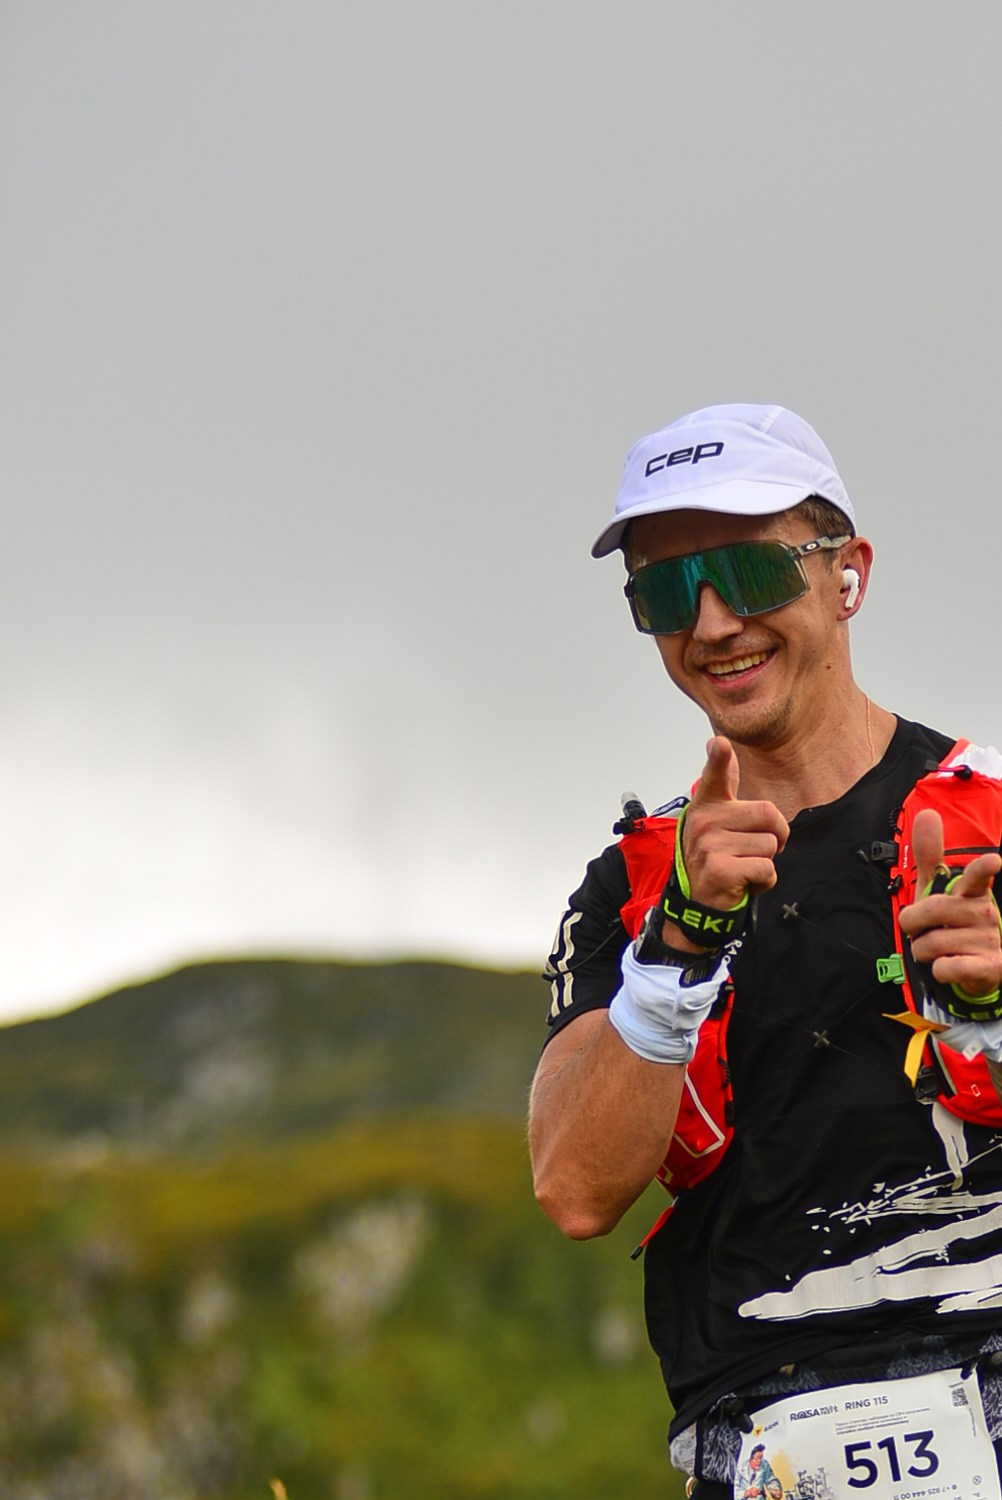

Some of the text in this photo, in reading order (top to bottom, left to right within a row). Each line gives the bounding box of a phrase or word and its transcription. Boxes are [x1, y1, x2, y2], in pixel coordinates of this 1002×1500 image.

[644, 442, 725, 478] cep
[663, 898, 735, 933] LEKI
[845, 1398, 871, 1411] RING
[873, 1395, 889, 1406] 115
[844, 1429, 940, 1489] 513
